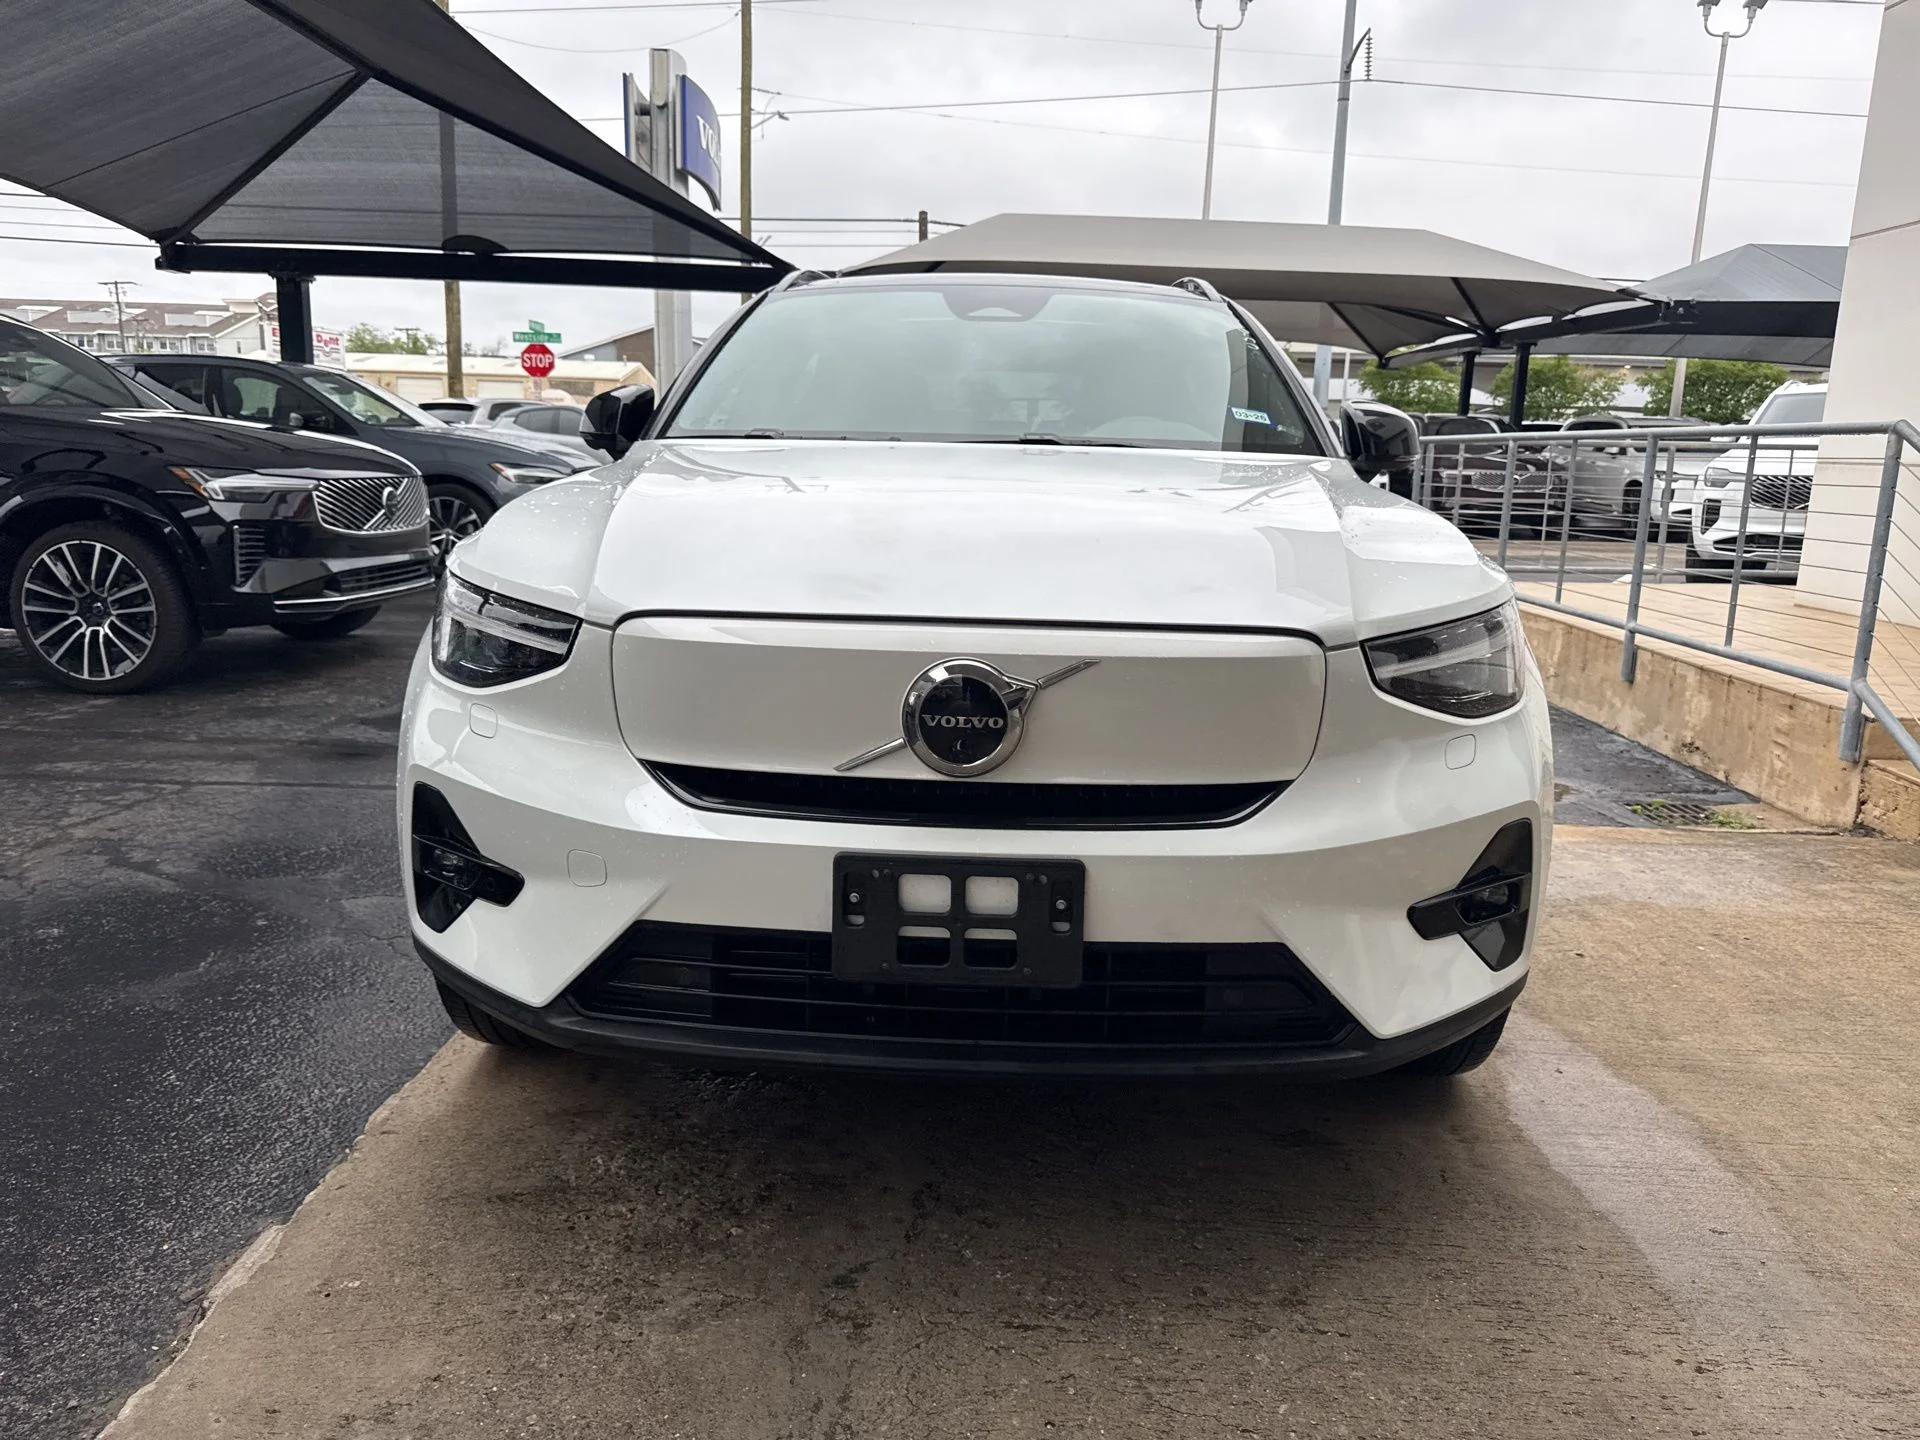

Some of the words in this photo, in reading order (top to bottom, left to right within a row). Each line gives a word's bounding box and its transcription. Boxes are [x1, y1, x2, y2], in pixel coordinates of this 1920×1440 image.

[316, 334, 340, 347] Dent
[523, 353, 553, 368] STOP
[921, 714, 1004, 729] VOLVO
